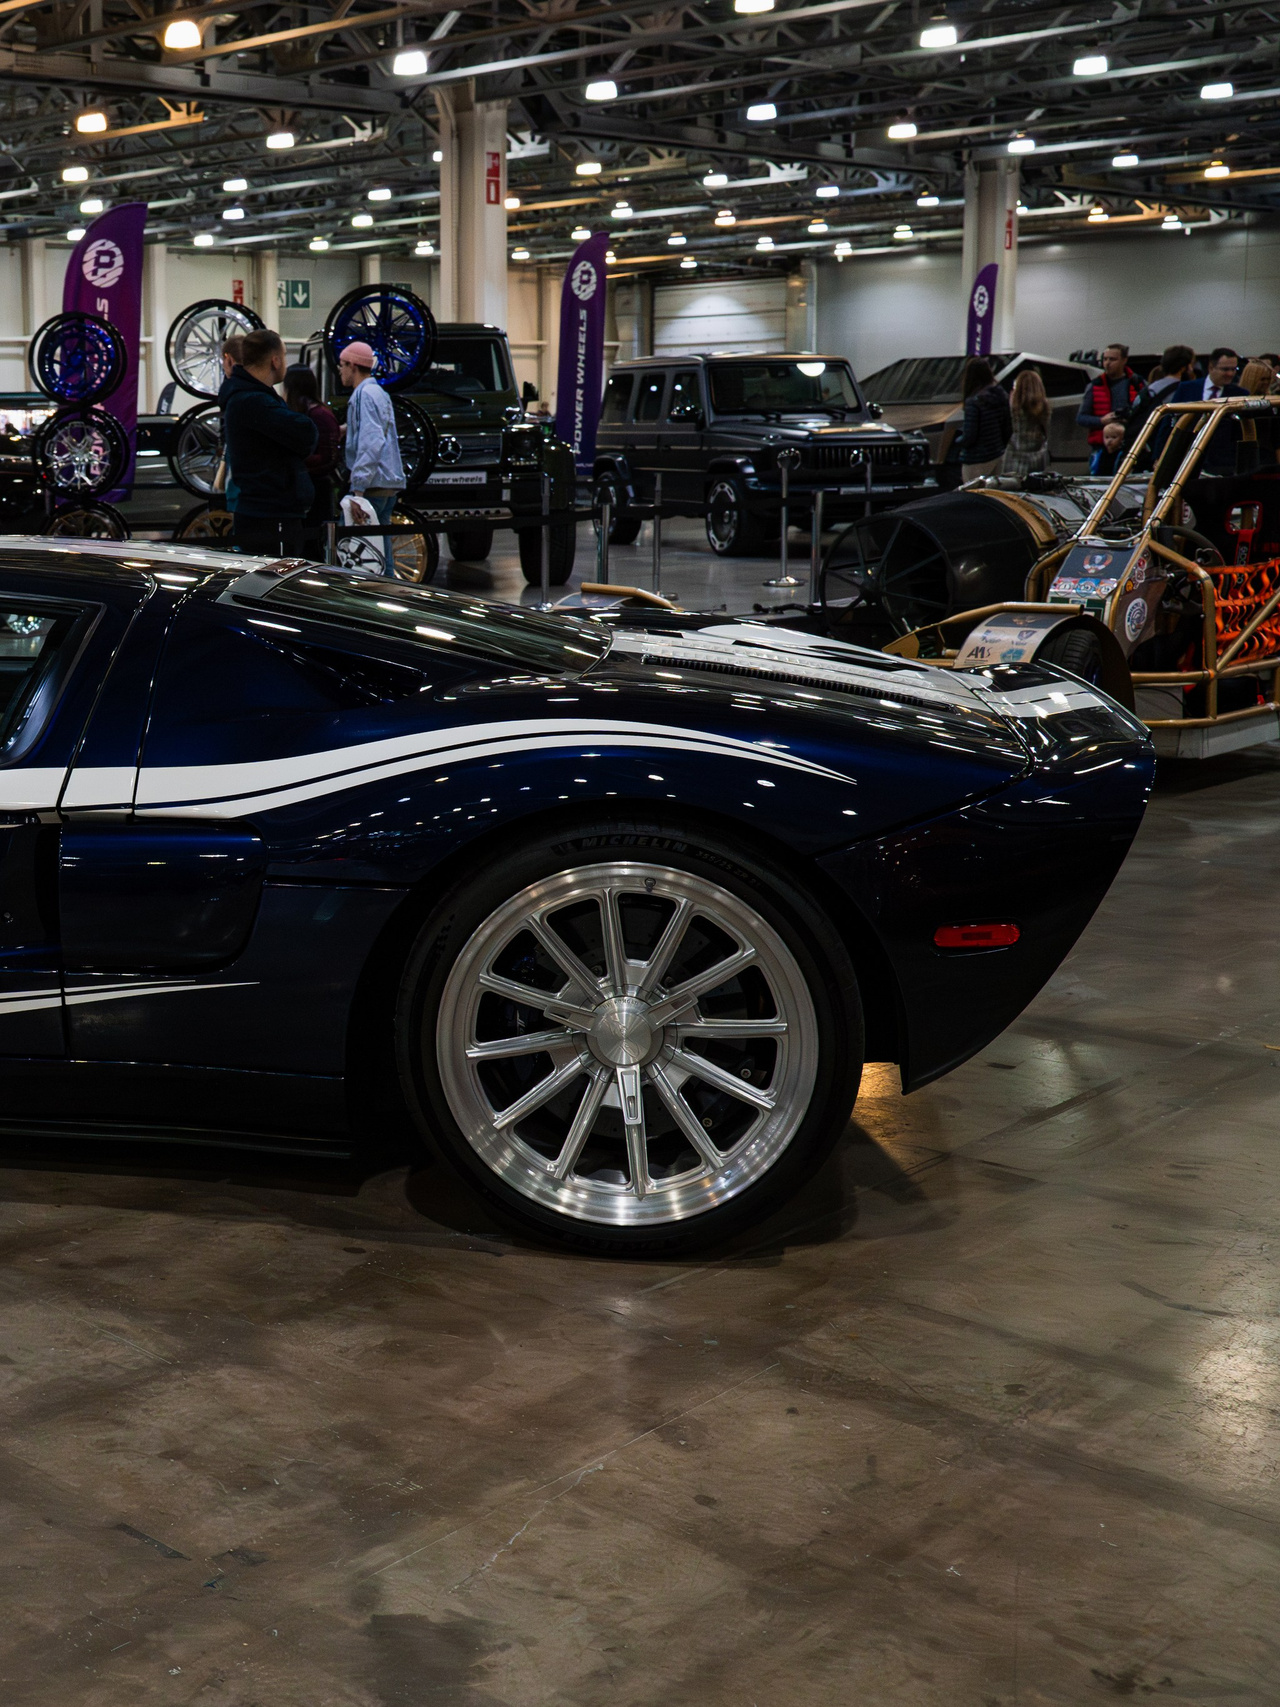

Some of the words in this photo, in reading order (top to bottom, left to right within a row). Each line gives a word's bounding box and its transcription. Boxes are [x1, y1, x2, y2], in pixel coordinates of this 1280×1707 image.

[575, 308, 588, 385] WHEELS
[572, 388, 584, 454] POWER
[581, 834, 688, 854] MICHELIN
